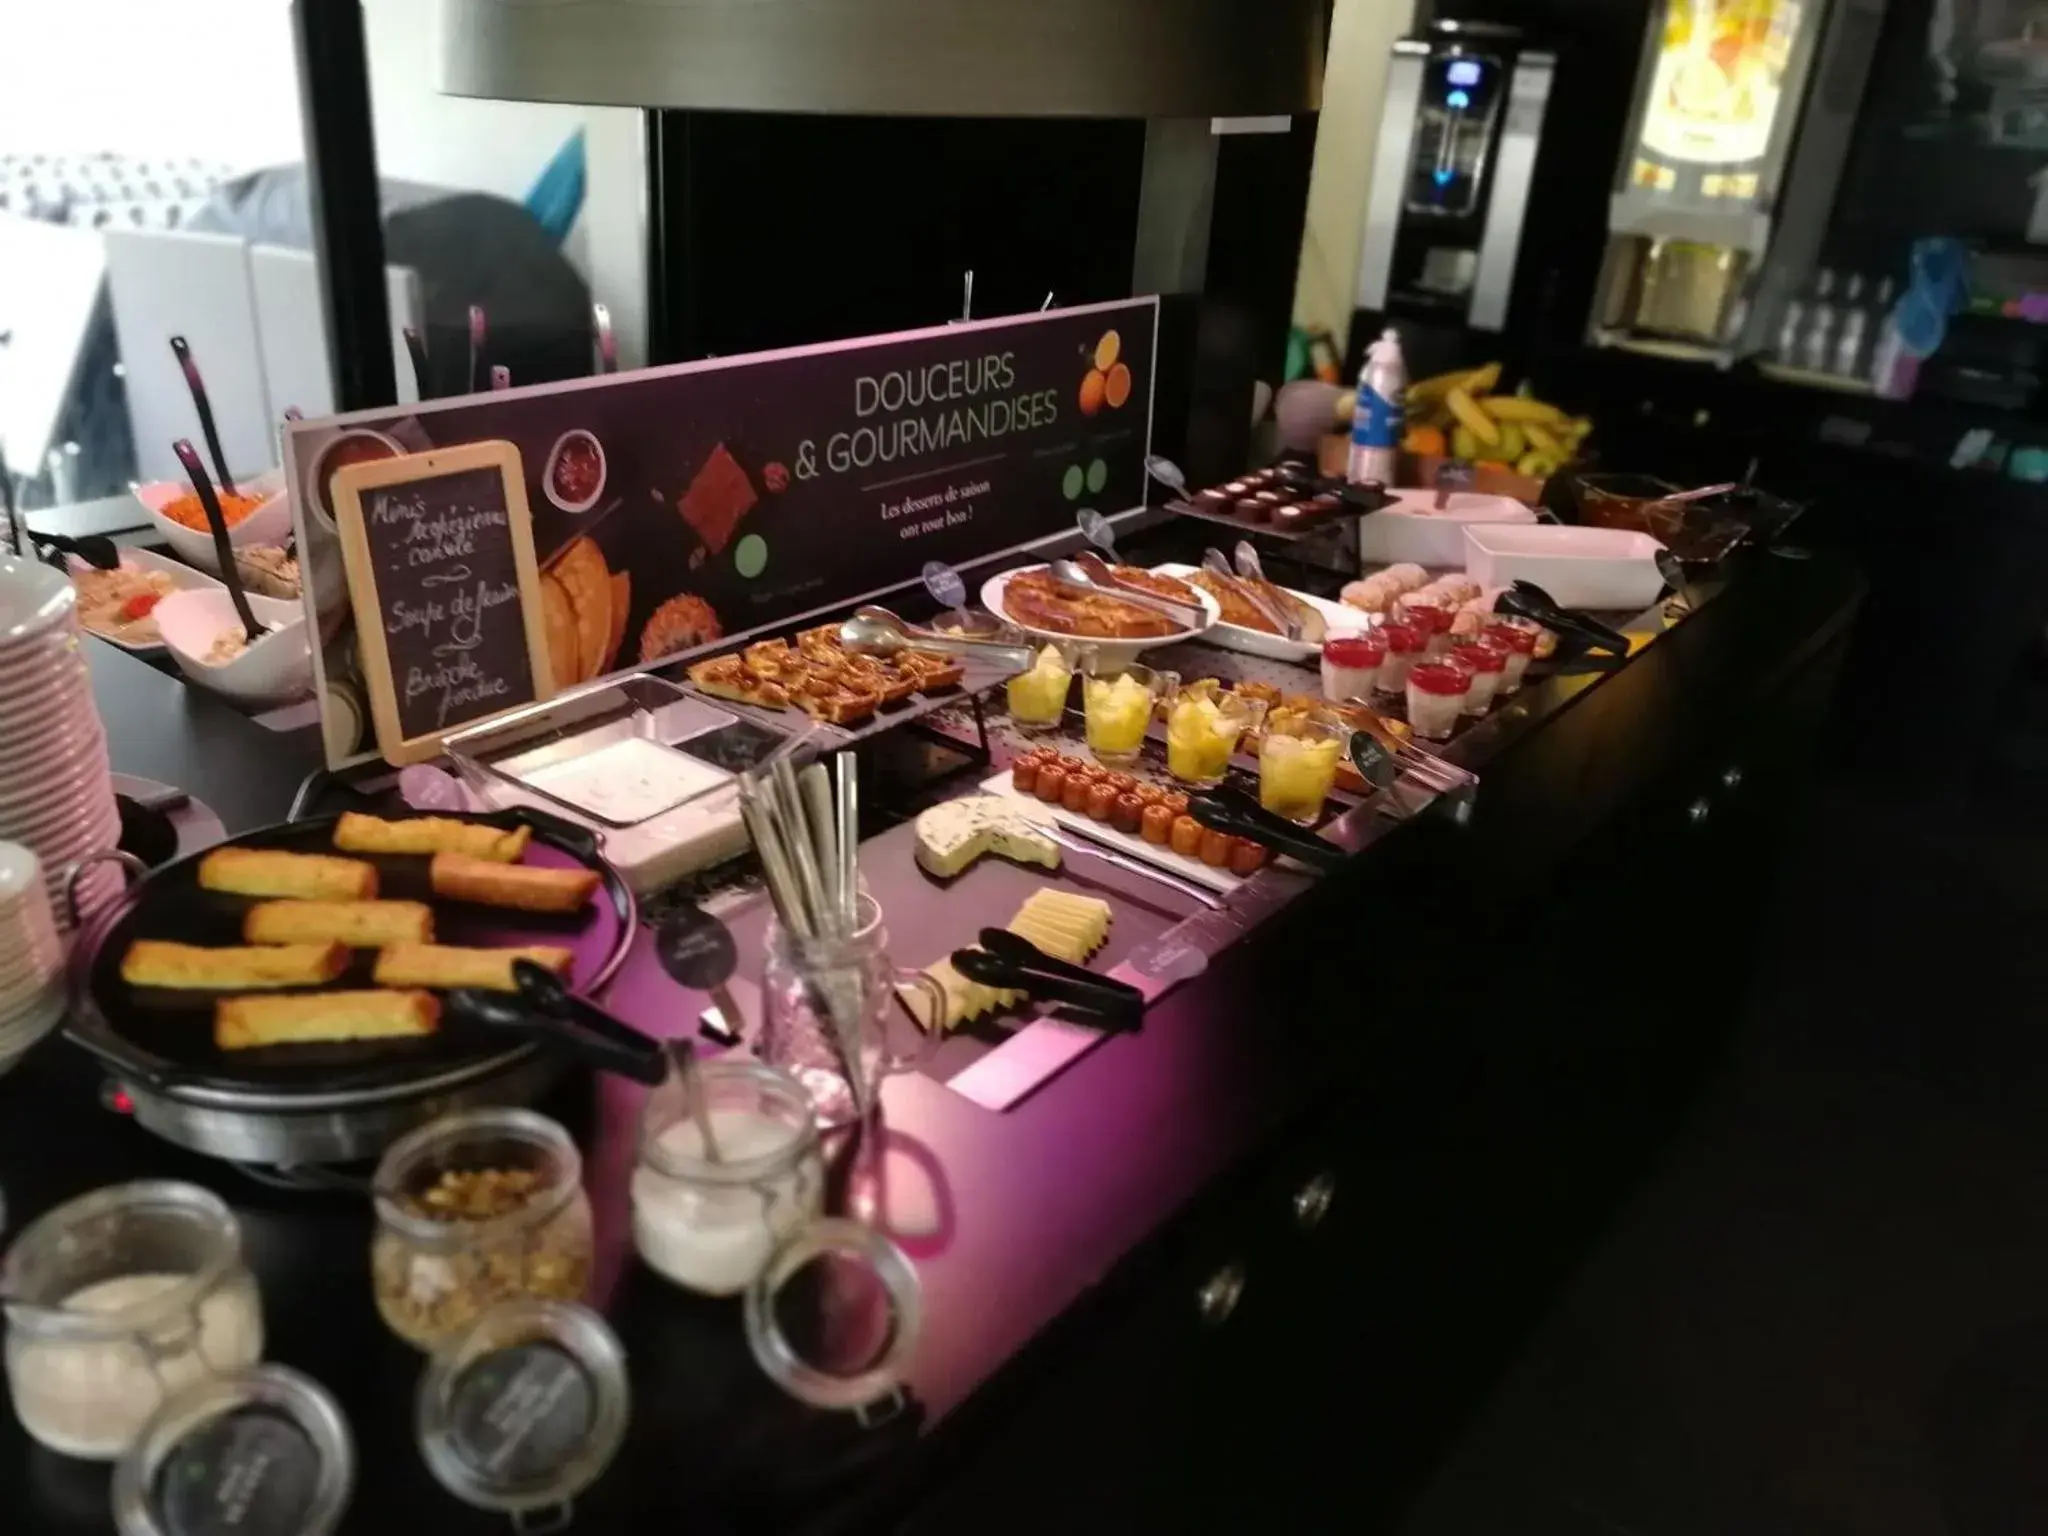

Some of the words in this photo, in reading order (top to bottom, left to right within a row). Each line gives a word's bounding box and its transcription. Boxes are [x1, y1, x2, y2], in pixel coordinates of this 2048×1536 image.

[855, 352, 1015, 418] DOUCEURS
[795, 440, 820, 480] &
[826, 389, 1058, 473] GOURMANDISES
[880, 502, 900, 520] Les
[901, 496, 944, 515] desserts
[944, 485, 959, 503] de
[960, 481, 991, 499] saison
[900, 523, 920, 539] ont
[921, 517, 945, 534] tout
